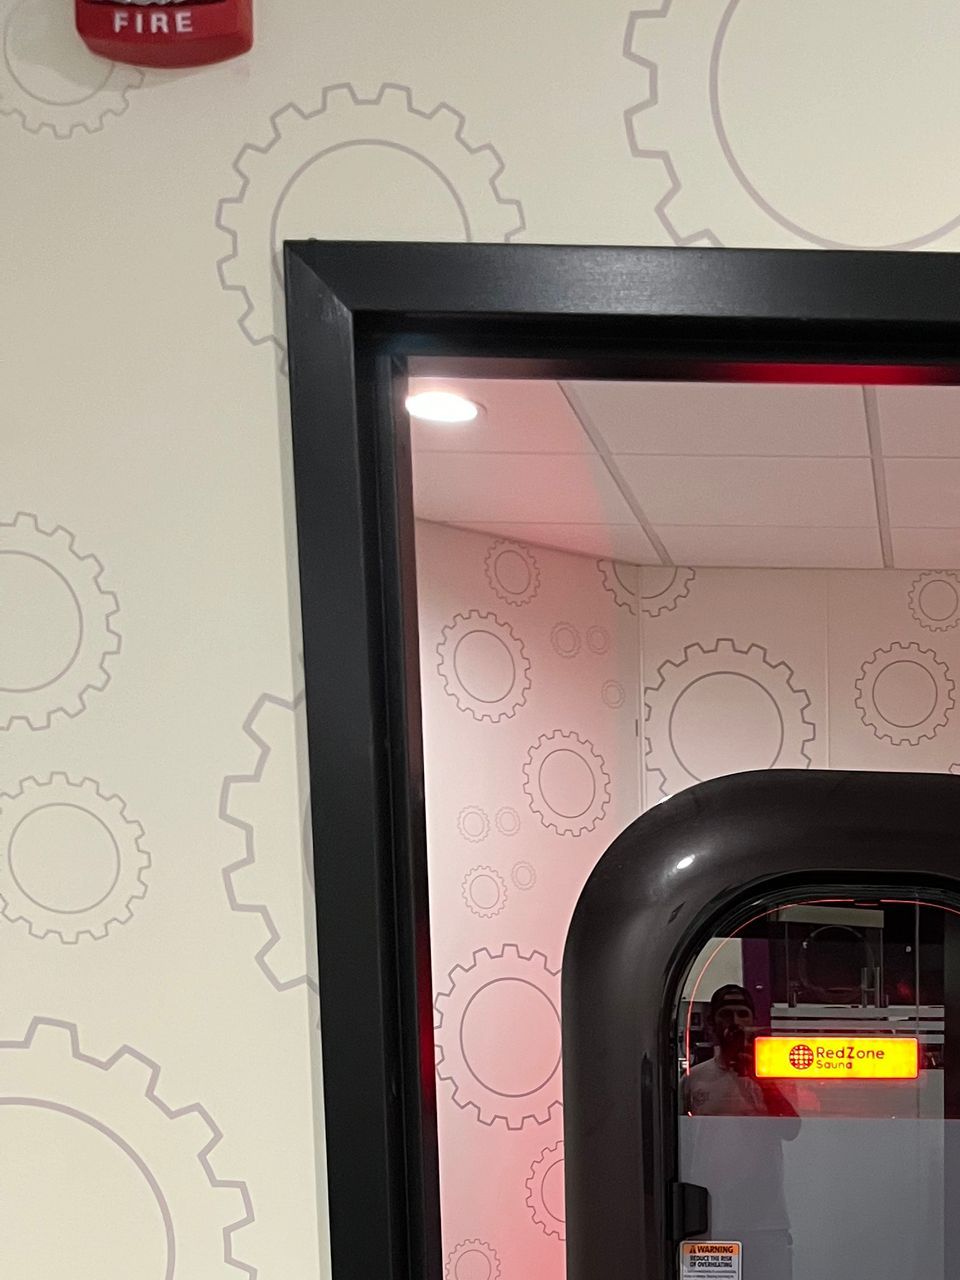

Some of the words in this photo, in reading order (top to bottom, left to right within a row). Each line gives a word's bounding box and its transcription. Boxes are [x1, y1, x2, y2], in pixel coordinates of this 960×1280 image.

[114, 11, 193, 33] FIRE
[816, 1046, 885, 1060] RedZone
[816, 1060, 853, 1070] Sauna
[697, 1245, 734, 1253] WARNING
